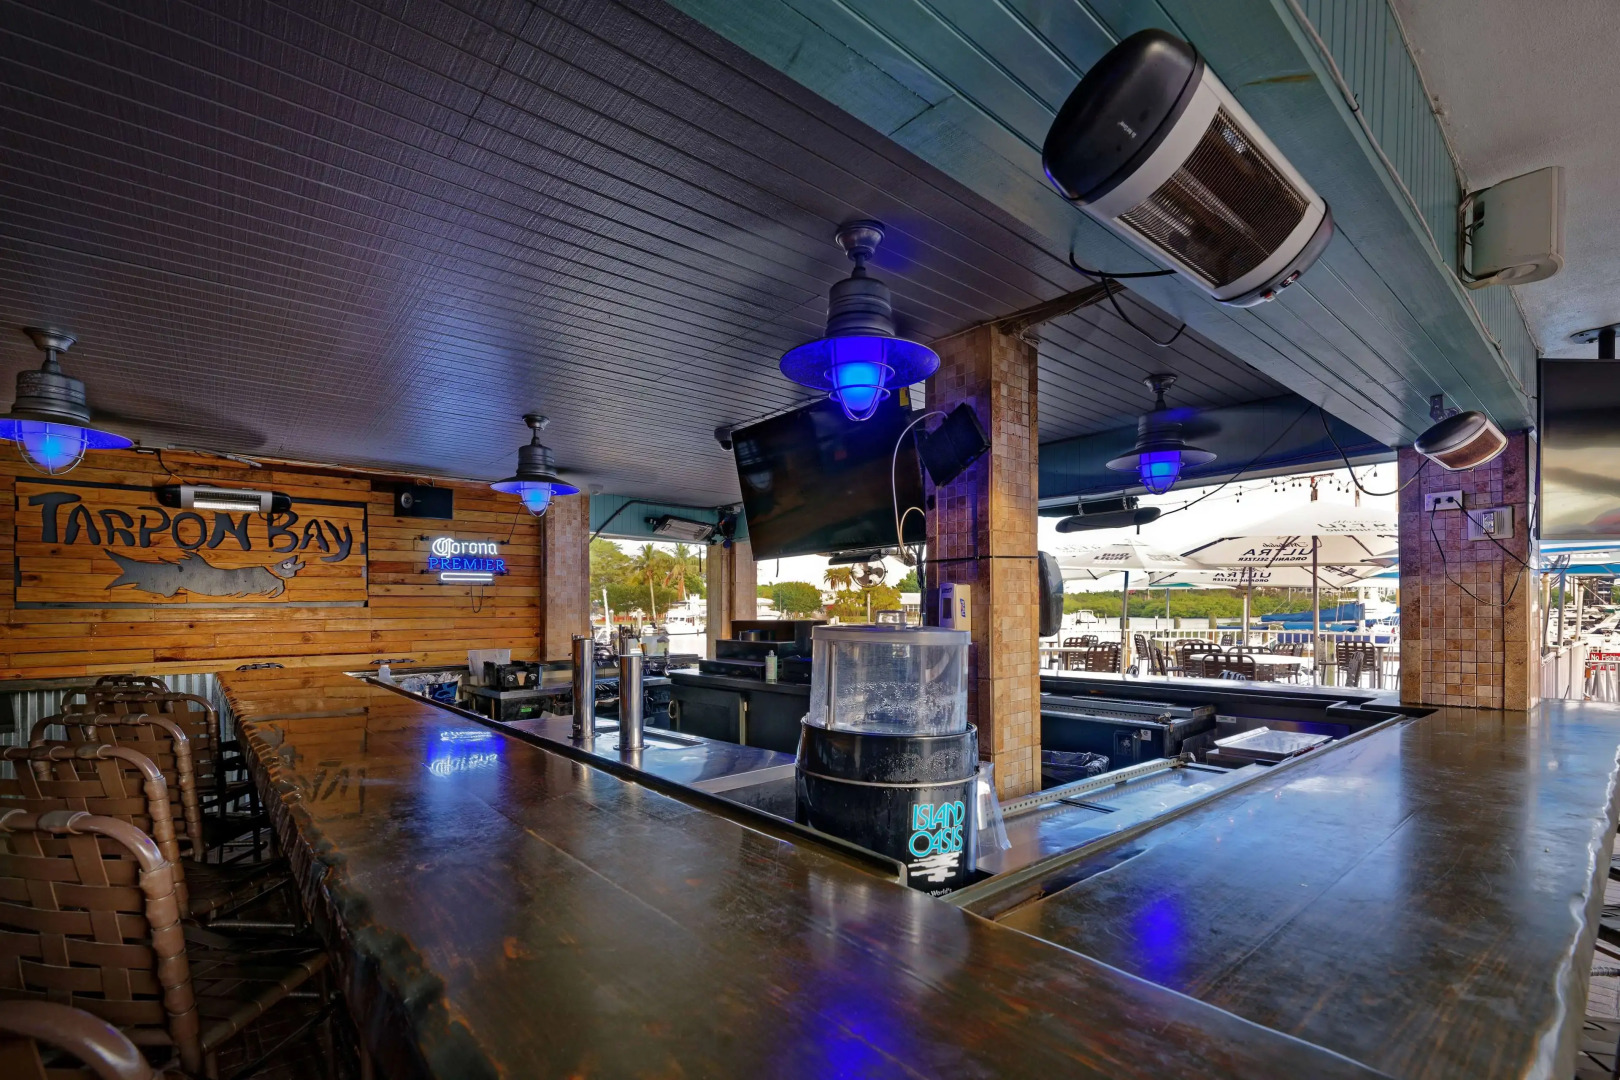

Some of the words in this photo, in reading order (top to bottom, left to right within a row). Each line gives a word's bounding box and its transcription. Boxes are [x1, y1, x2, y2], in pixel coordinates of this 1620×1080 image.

[28, 492, 251, 551] TARPON
[267, 510, 353, 562] BAY
[432, 537, 498, 558] Corona
[428, 557, 505, 571] PREMIER
[912, 801, 965, 830] ISLAND
[908, 825, 963, 857] OASIS
